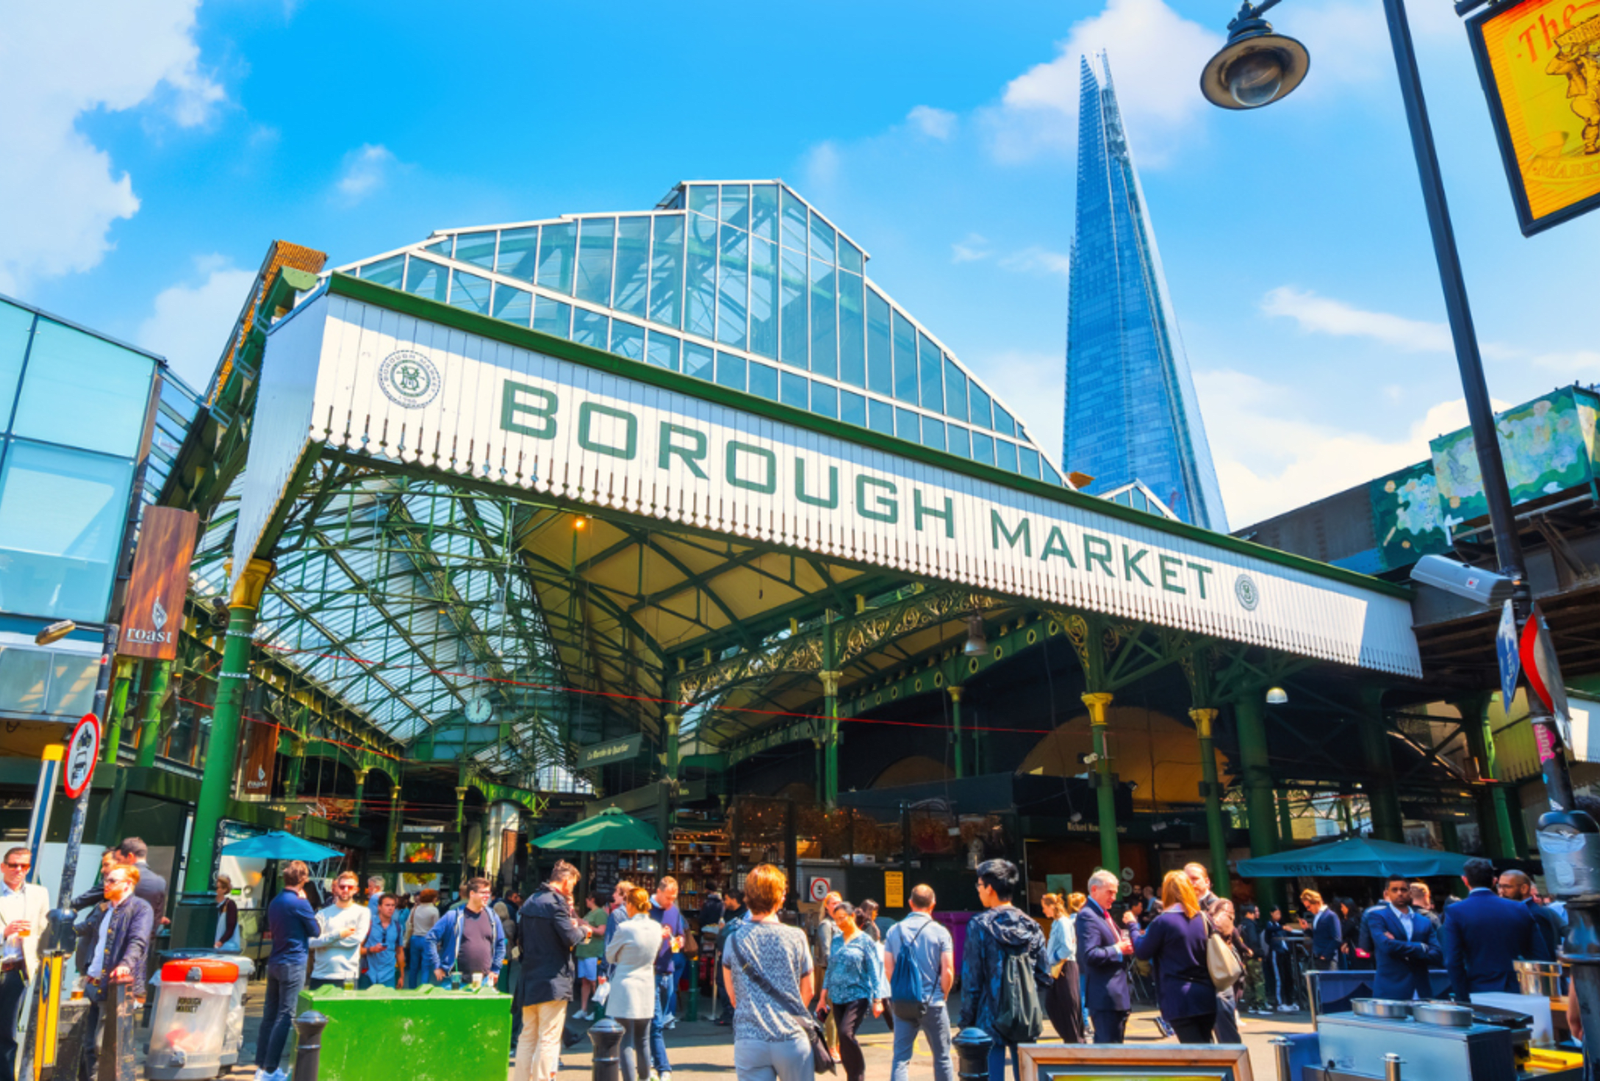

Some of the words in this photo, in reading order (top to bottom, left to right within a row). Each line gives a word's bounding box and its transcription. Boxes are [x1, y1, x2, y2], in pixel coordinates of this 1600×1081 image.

[1518, 3, 1584, 63] The
[1535, 160, 1600, 180] MARK
[499, 378, 955, 539] BOROUGH
[989, 507, 1214, 600] MARKET
[127, 628, 172, 644] roast
